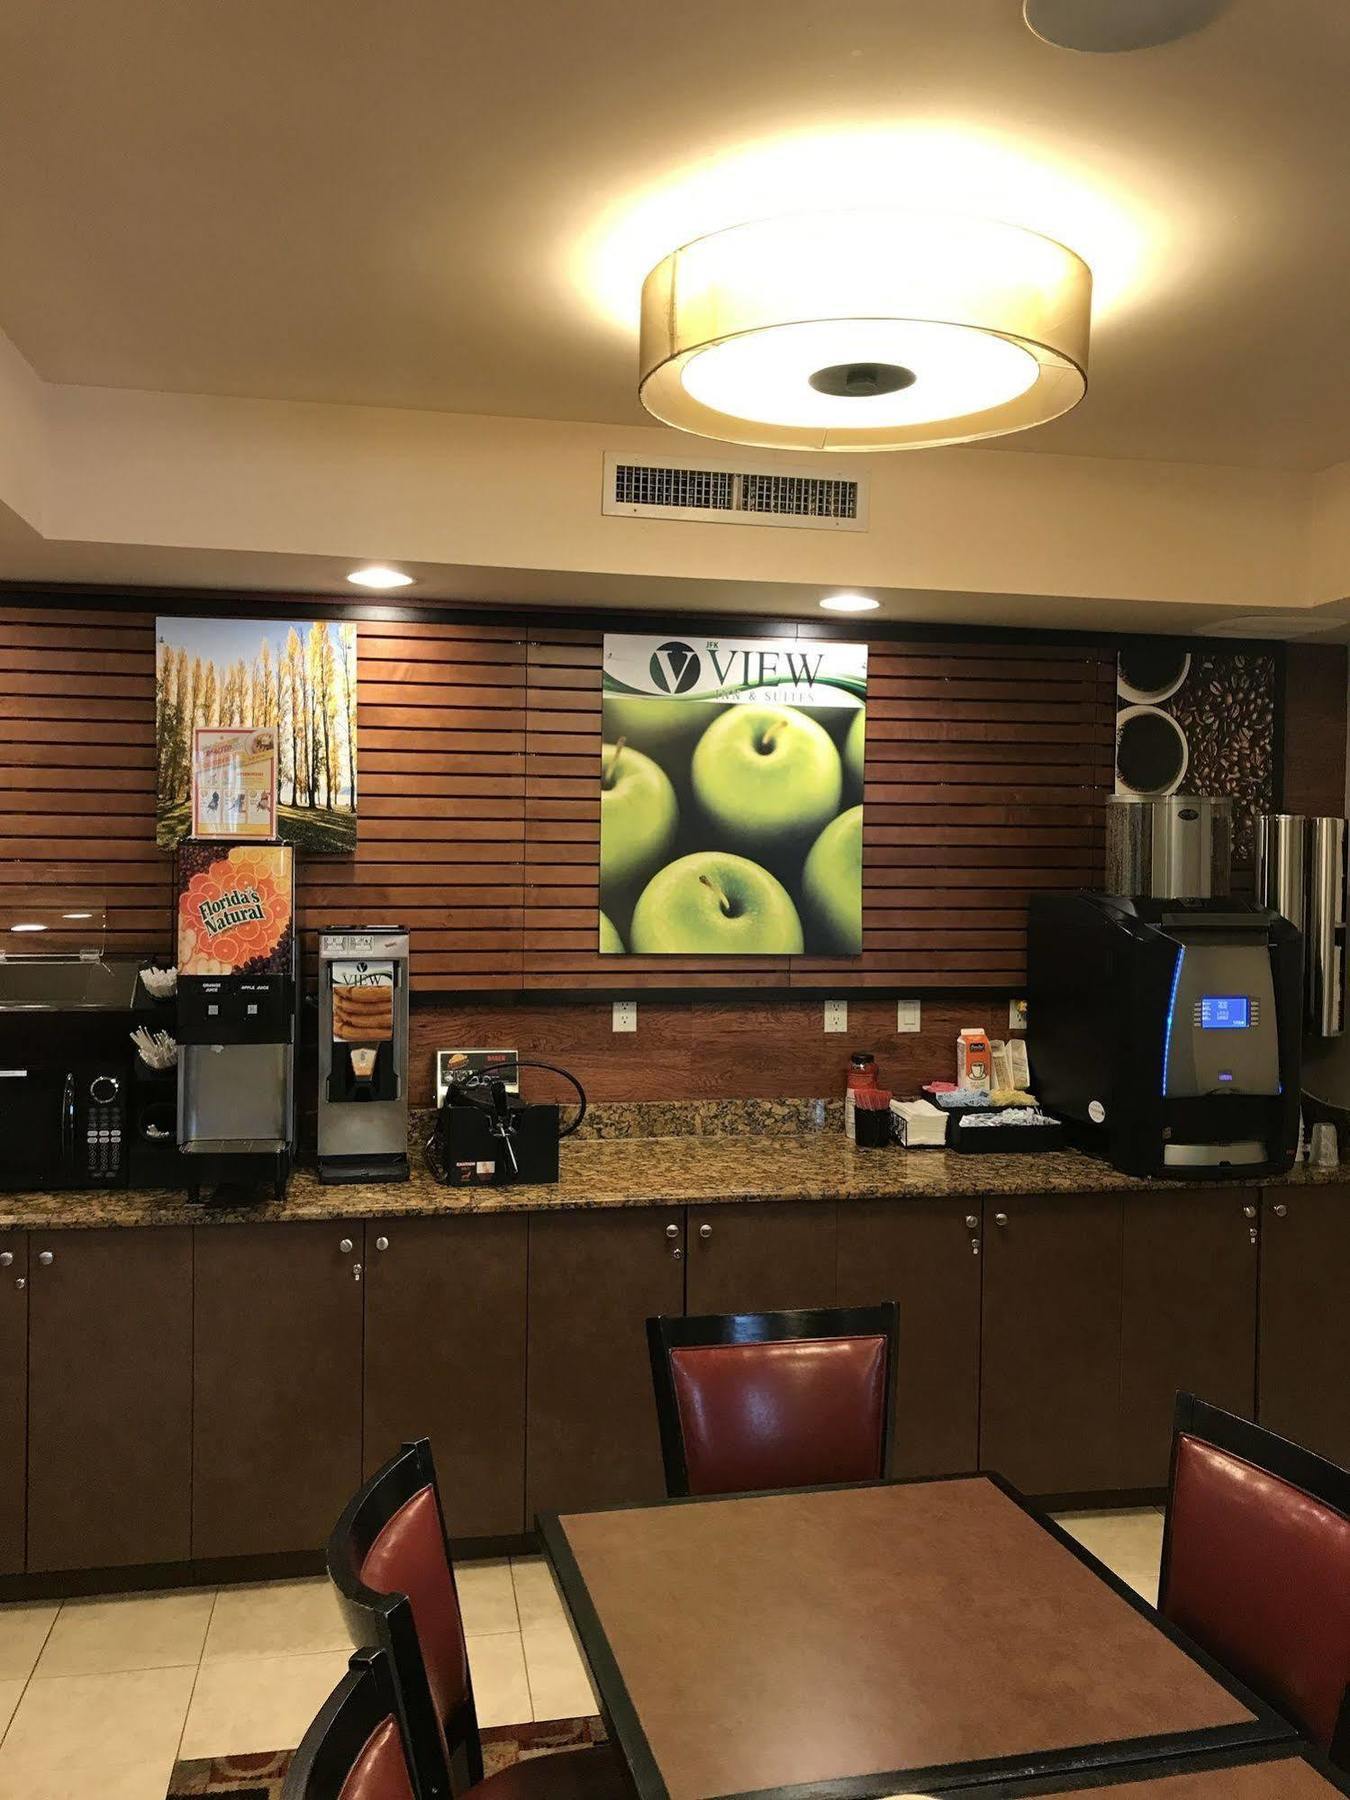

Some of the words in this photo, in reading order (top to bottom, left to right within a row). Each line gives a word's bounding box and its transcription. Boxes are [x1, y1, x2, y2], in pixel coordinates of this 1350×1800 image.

[706, 641, 719, 649] JFK
[707, 649, 824, 689] VIEW
[765, 691, 815, 702] SUITES
[198, 889, 260, 920] Florida's
[204, 904, 264, 936] Natural
[343, 974, 382, 986] VIEW
